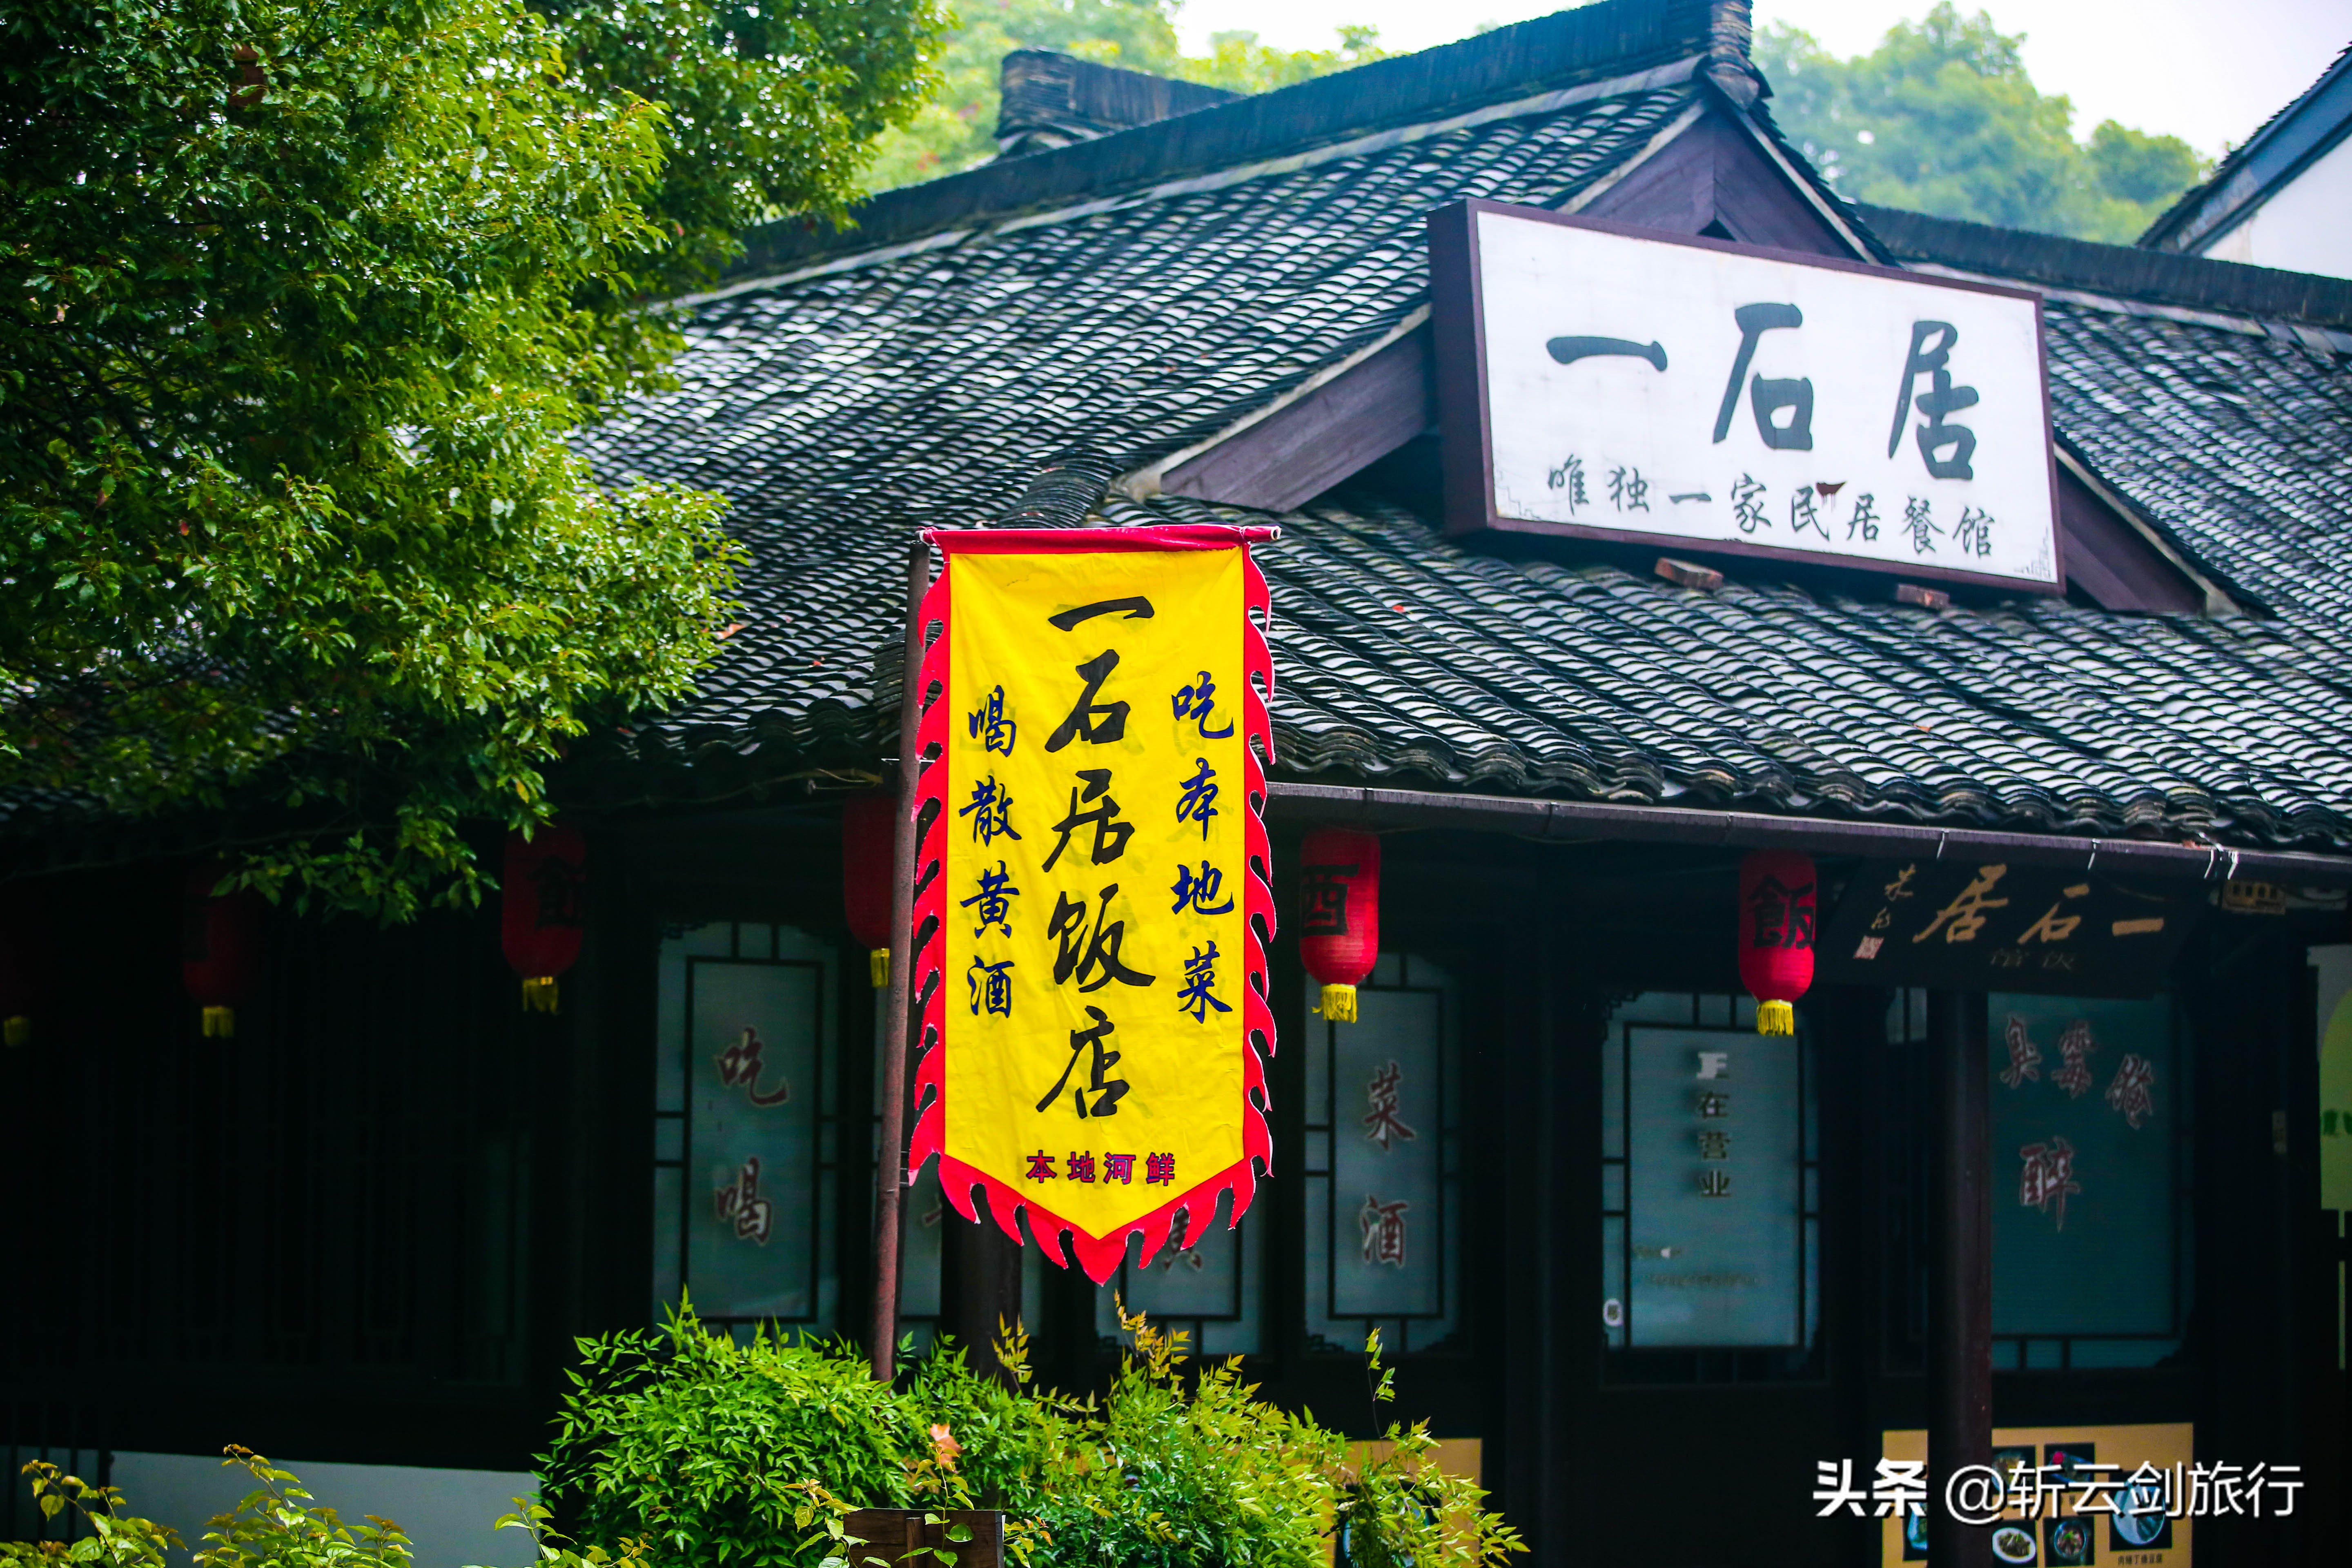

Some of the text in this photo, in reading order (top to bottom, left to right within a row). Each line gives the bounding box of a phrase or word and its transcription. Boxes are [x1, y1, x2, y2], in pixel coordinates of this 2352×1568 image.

[1546, 302, 1979, 481] 一石居
[1548, 454, 1996, 559] 唯独一家民居餐馆
[959, 684, 1022, 1018] 喝散黄酒
[1036, 595, 1156, 1119] 一石居饭店
[1170, 670, 1234, 1024] 吃本地菜
[1026, 1149, 1175, 1187] 本地河鲜
[1695, 1051, 1731, 1198] 正在营业
